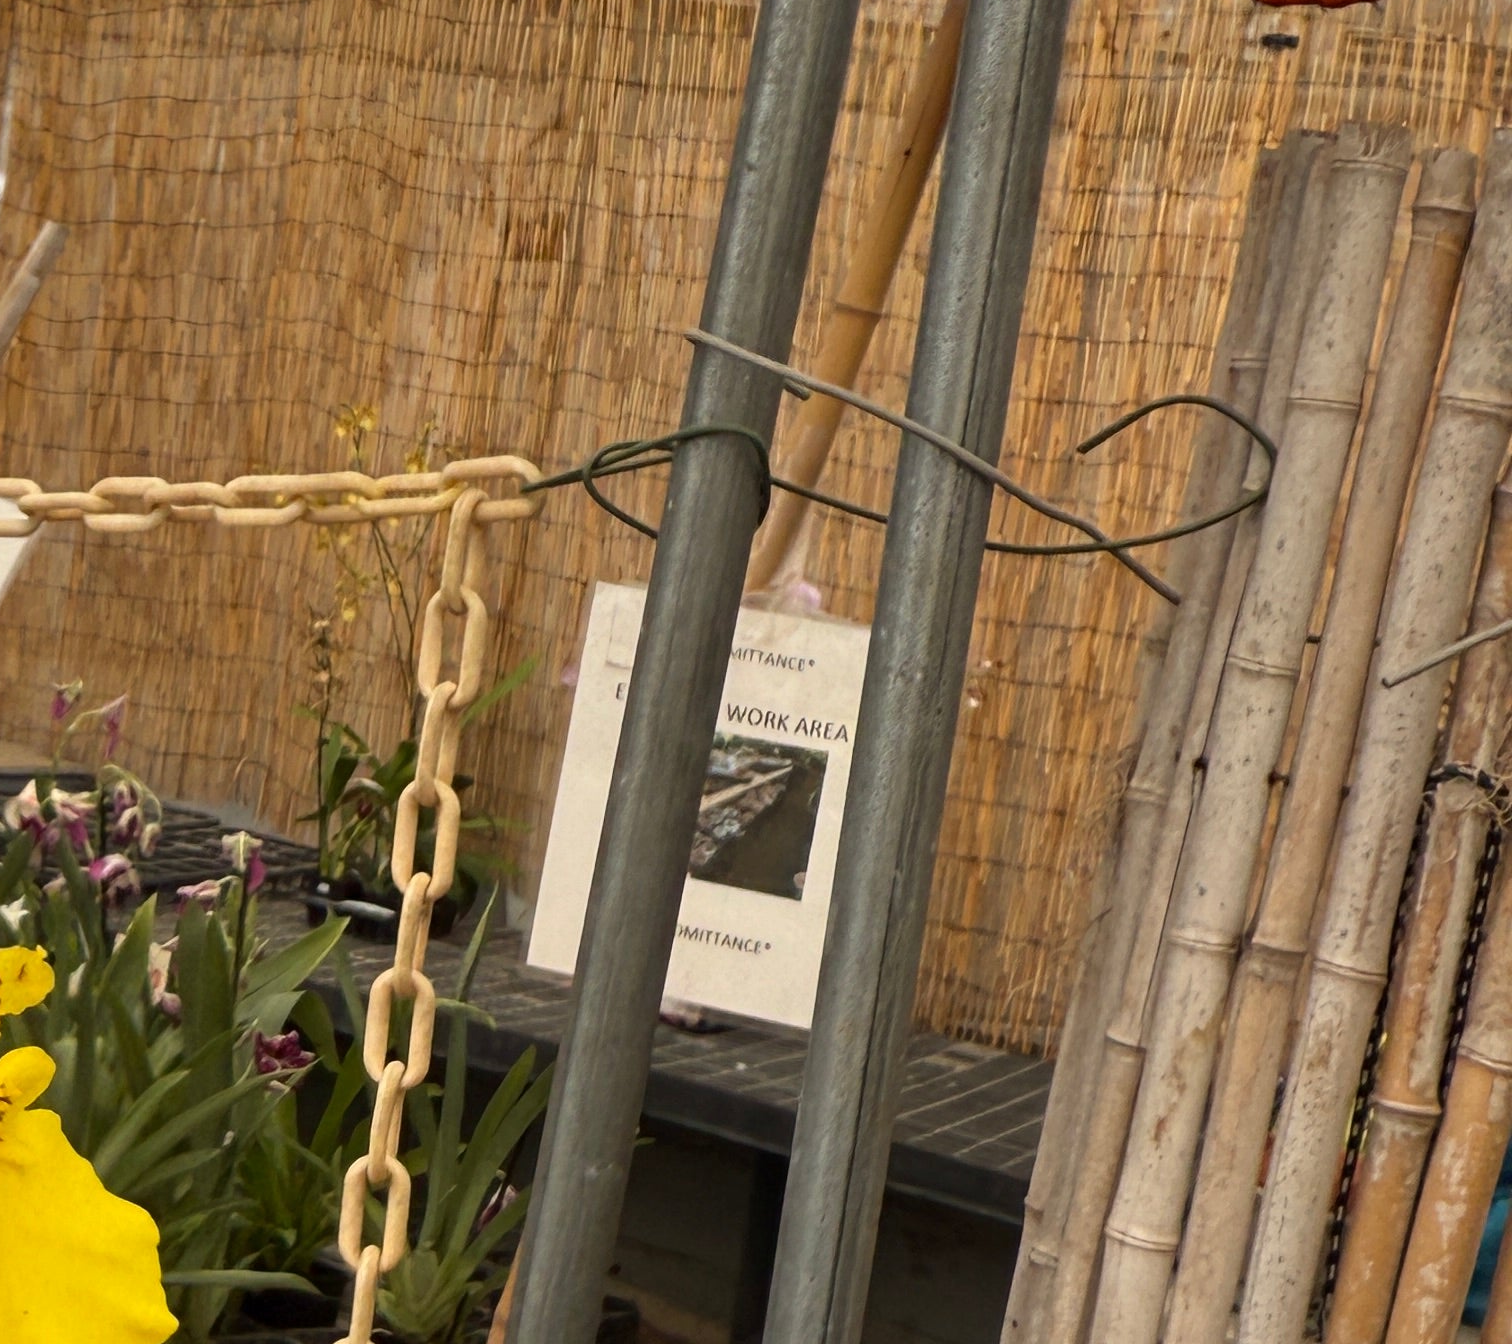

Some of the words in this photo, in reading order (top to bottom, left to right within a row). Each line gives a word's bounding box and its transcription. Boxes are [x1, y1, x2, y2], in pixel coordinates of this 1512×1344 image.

[730, 646, 816, 672] MITTANCE
[726, 702, 790, 733] WORK
[794, 717, 849, 743] AREA
